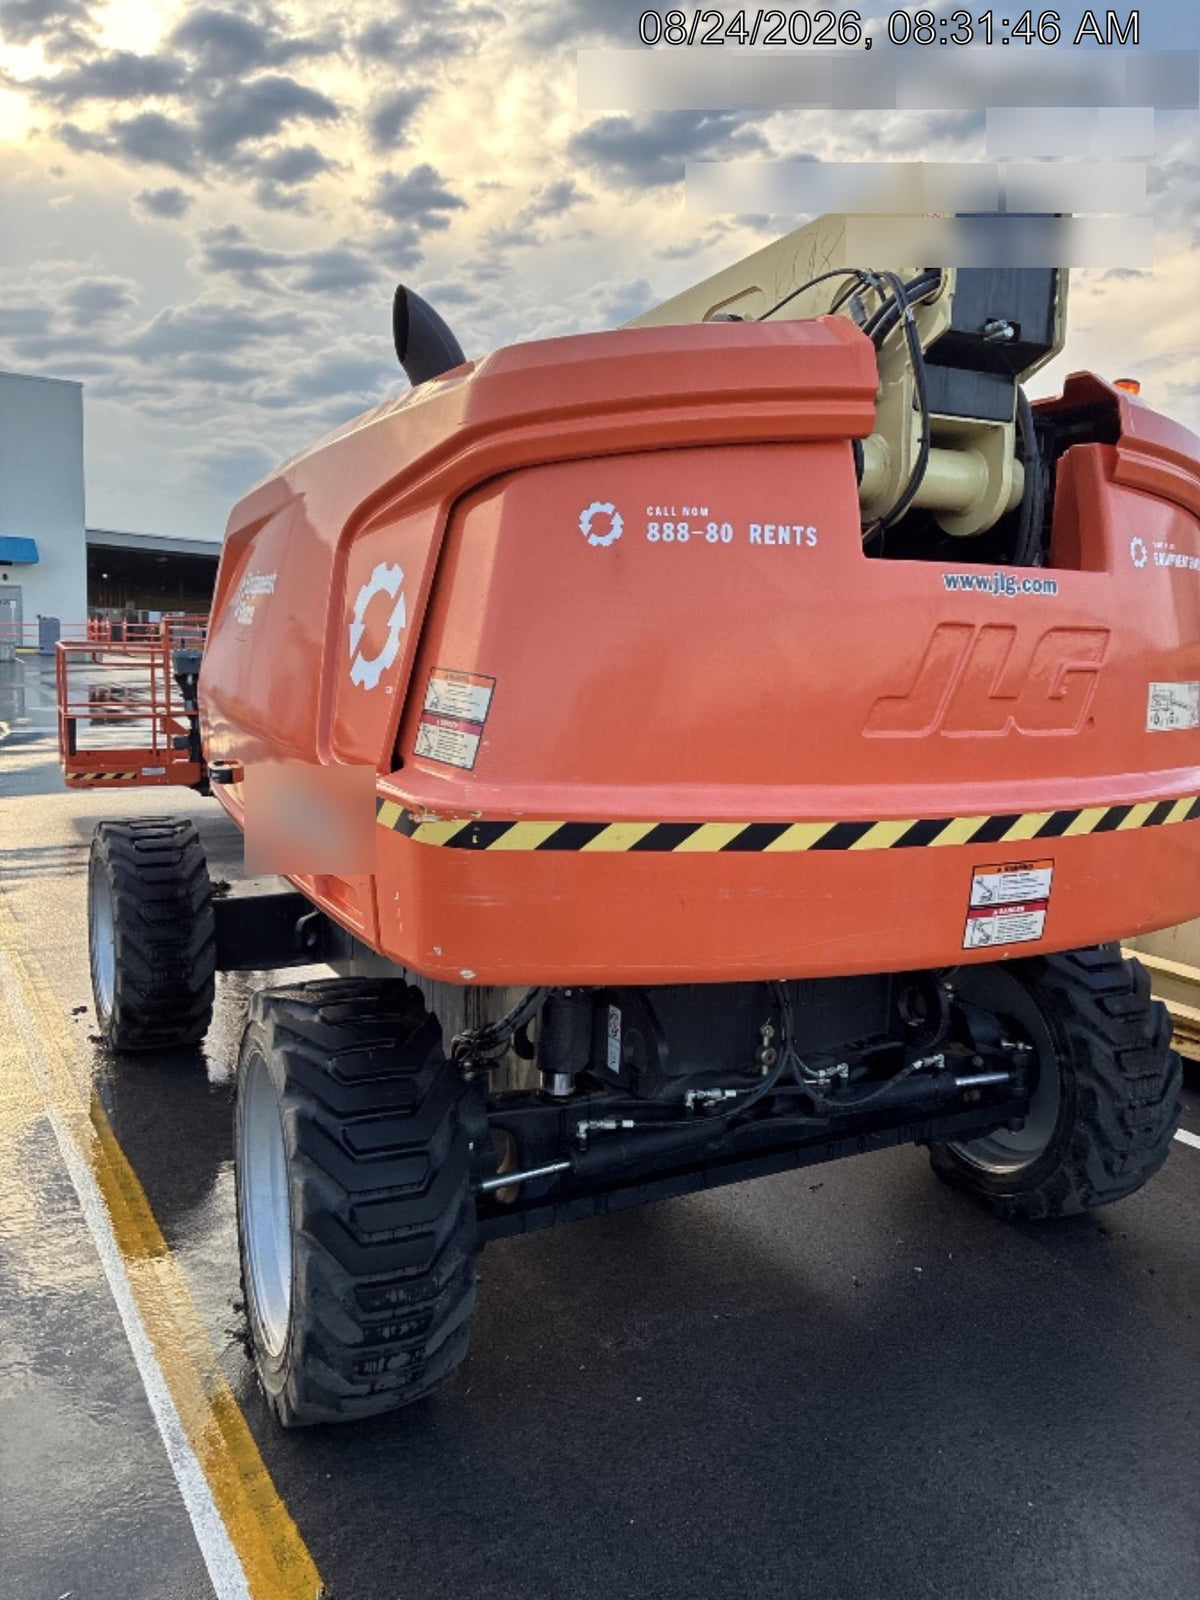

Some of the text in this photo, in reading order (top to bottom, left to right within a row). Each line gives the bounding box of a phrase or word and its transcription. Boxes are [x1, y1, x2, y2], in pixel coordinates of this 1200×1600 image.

[646, 506, 708, 516] CALL NOW
[646, 521, 818, 547] 888-80 RENTS
[943, 572, 1058, 598] www.jlg.com
[862, 621, 1110, 739] JLG
